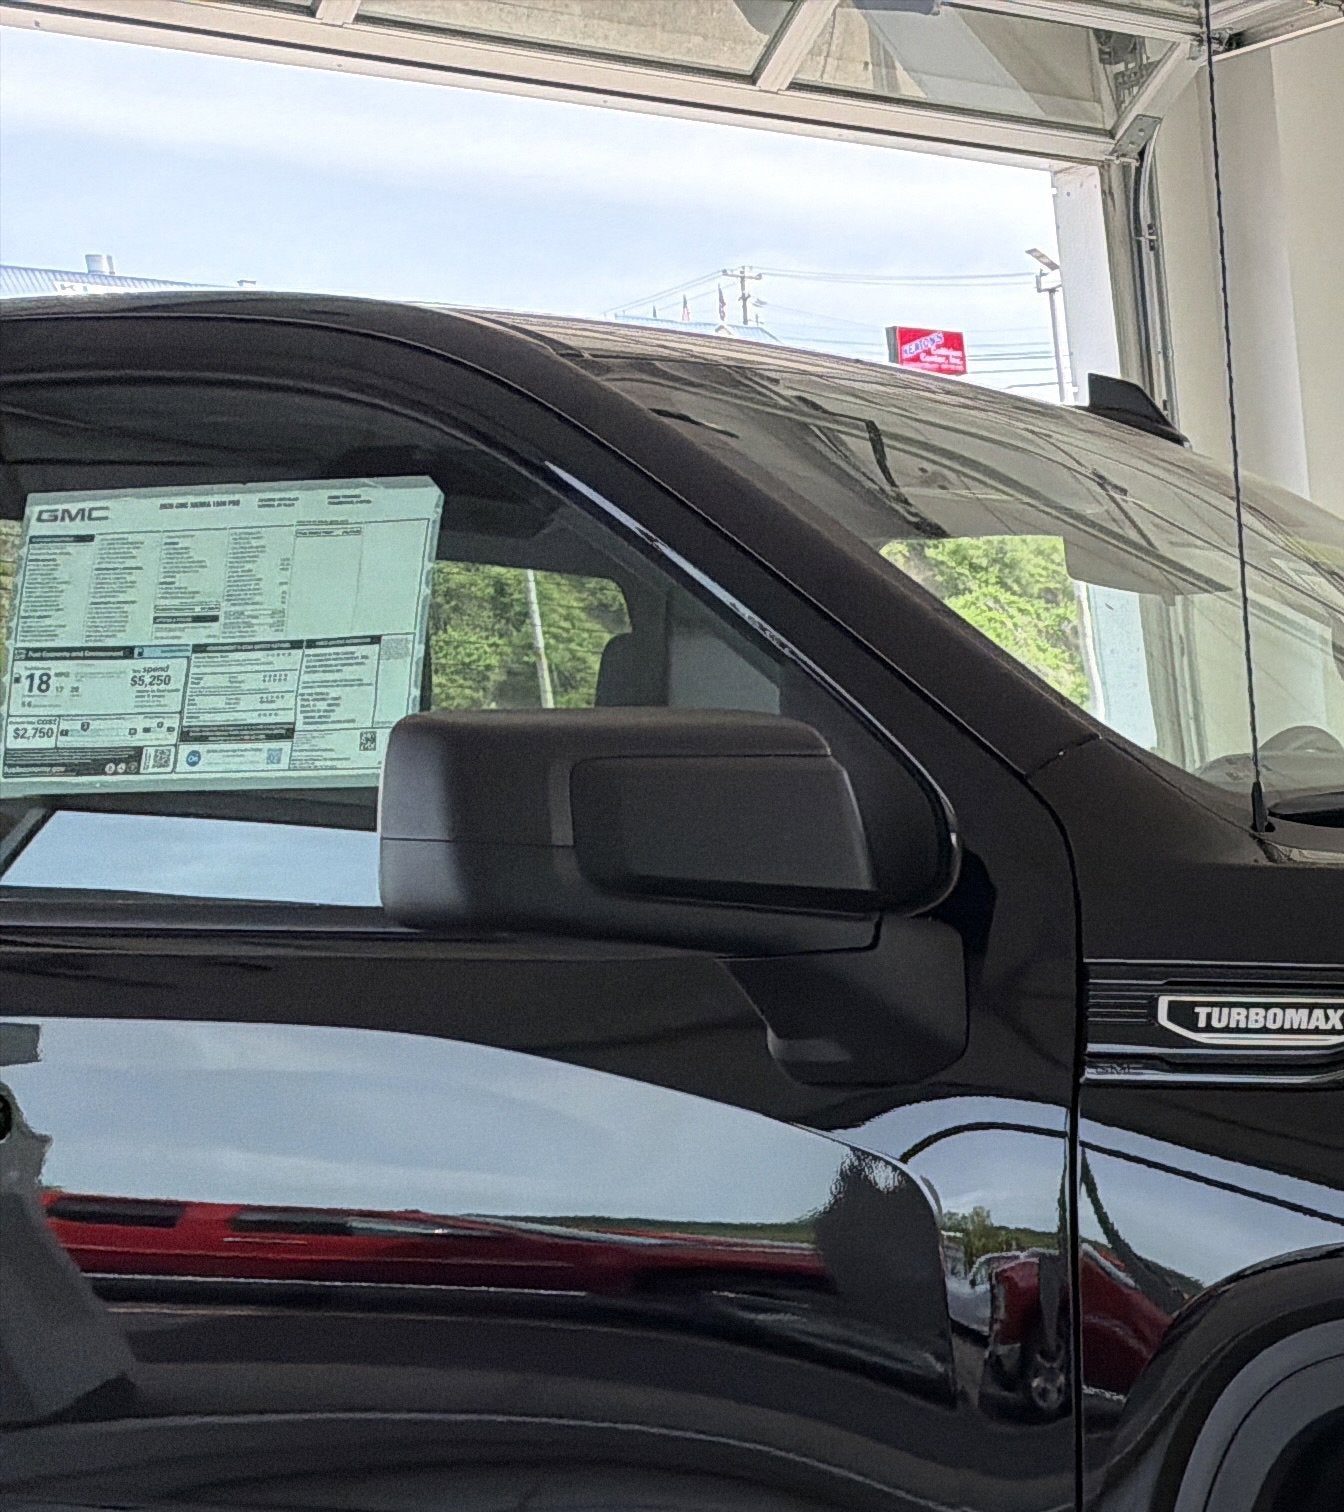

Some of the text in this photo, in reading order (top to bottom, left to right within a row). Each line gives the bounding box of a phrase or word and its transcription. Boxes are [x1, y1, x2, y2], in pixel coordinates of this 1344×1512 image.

[36, 506, 110, 523] GMC
[25, 672, 52, 694] 18
[130, 674, 172, 688] $5,250
[12, 727, 55, 740] $2,750
[1194, 1006, 1344, 1030] TURBOMAX
